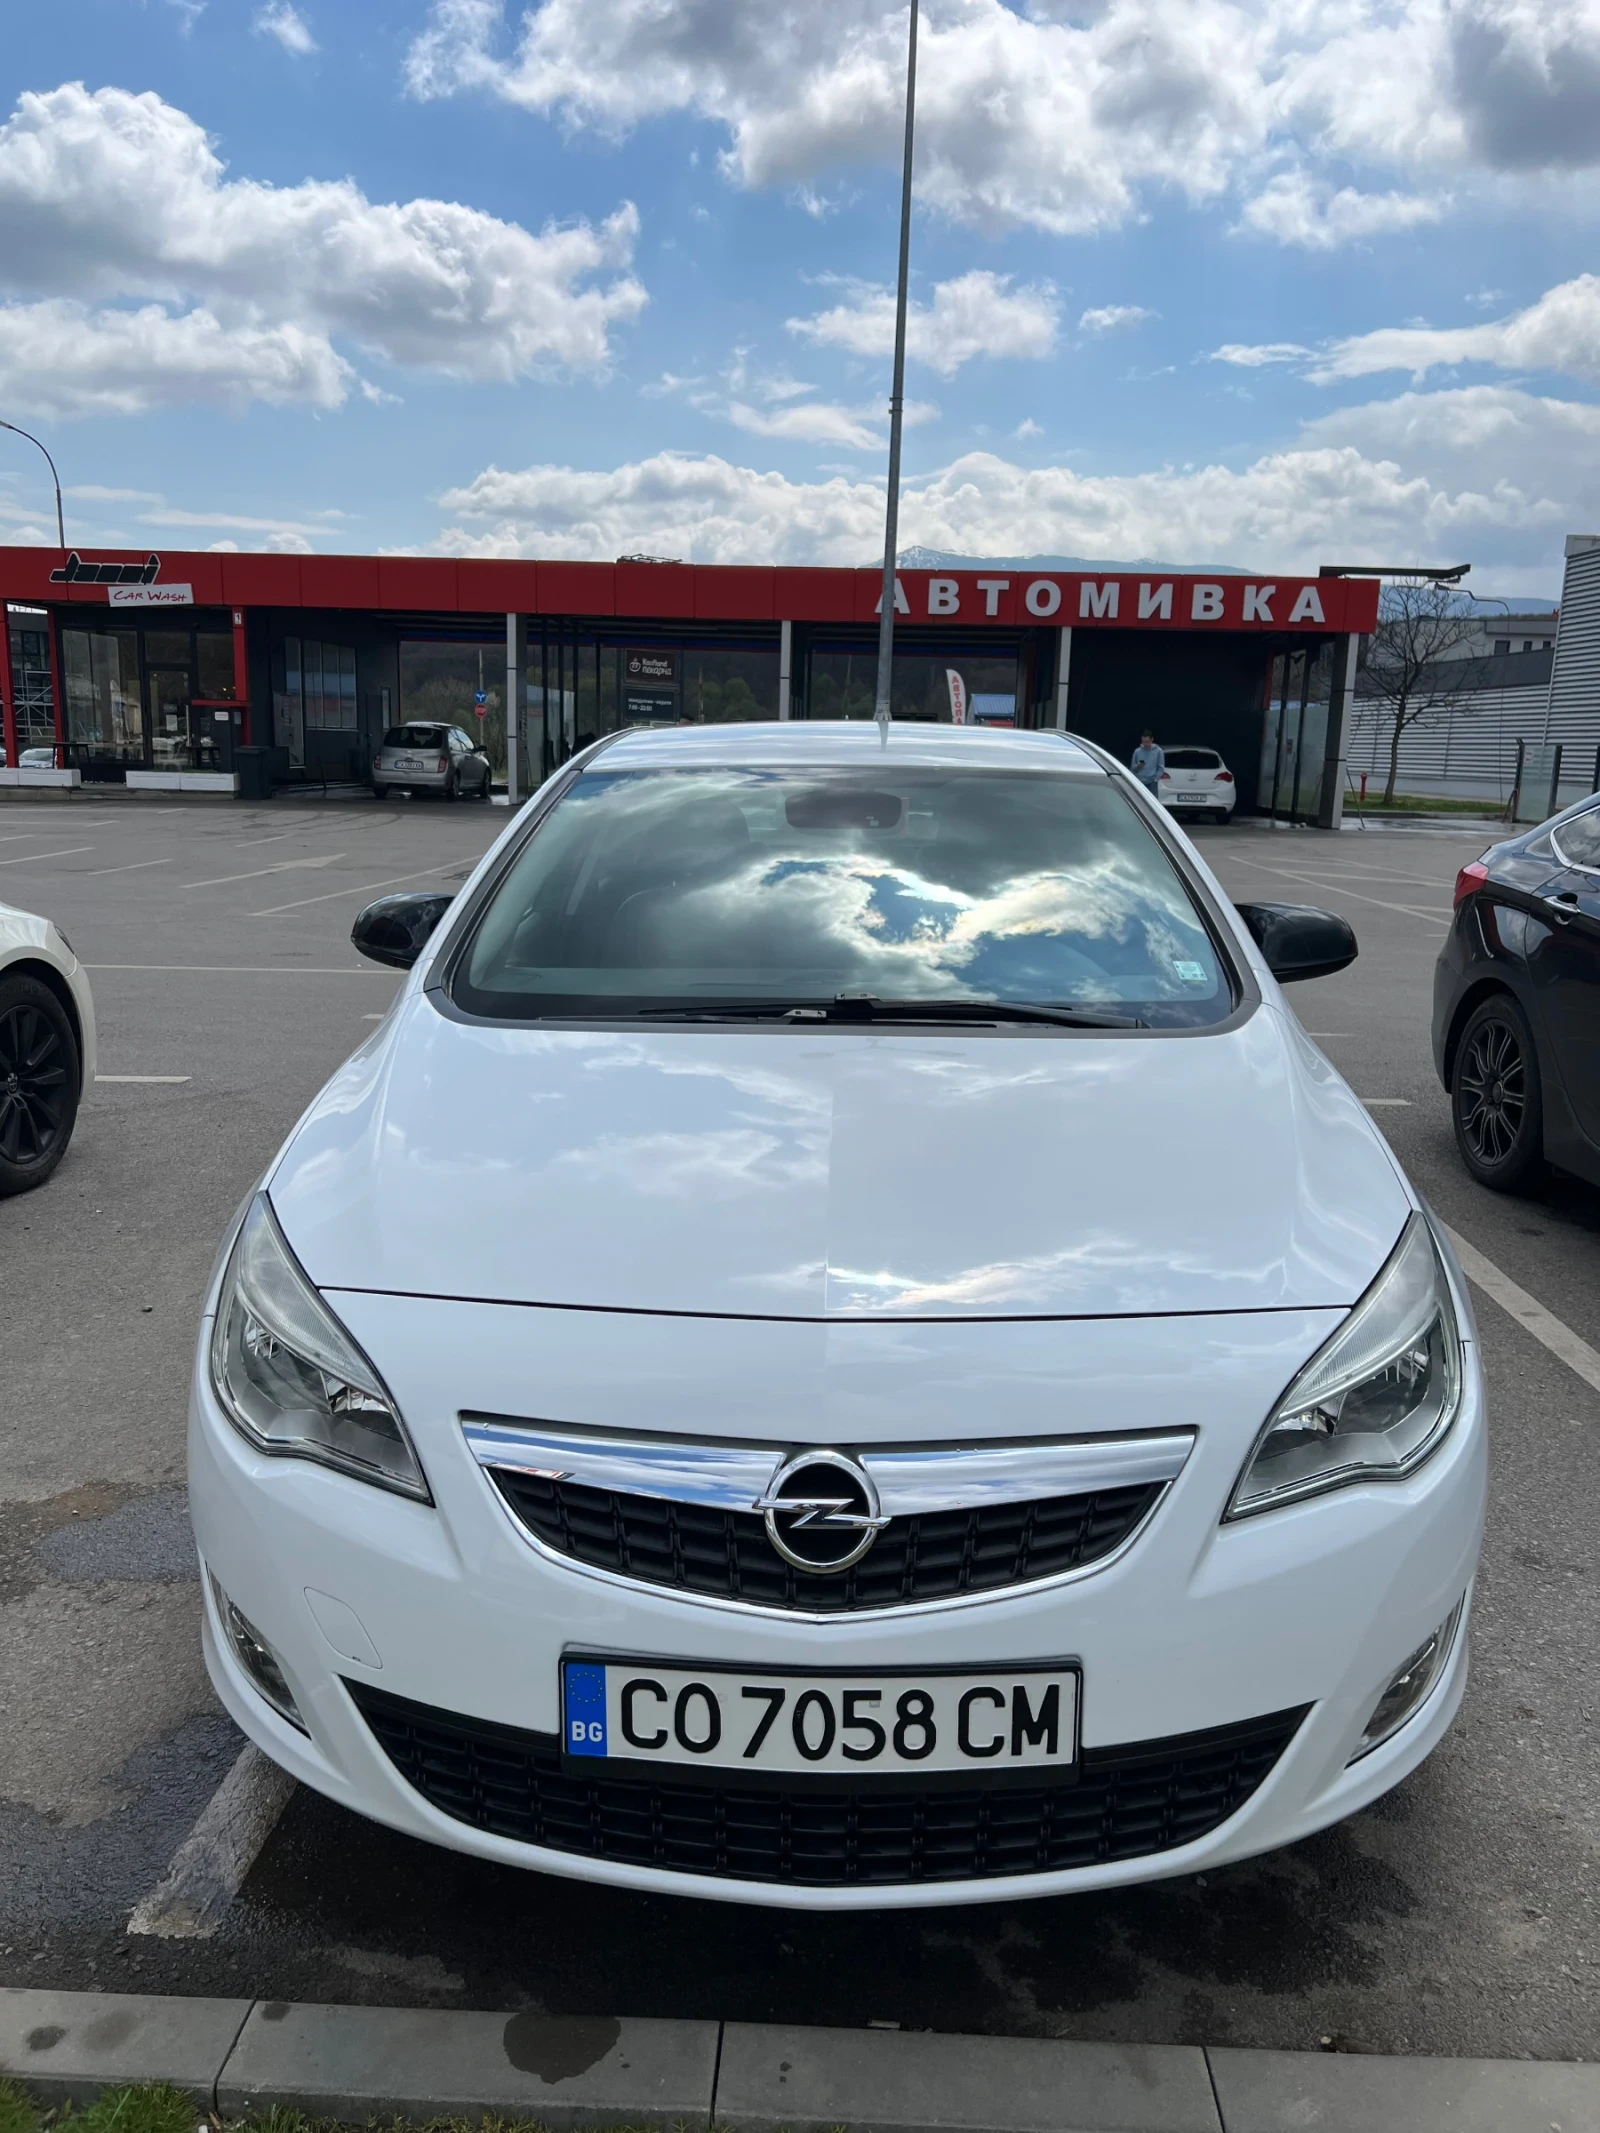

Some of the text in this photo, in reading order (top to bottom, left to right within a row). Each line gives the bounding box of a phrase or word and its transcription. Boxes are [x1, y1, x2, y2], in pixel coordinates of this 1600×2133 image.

[114, 591, 187, 603] CAR WASH
[874, 577, 1326, 624] АВТОМИВКА
[571, 1678, 1060, 1762] BG CO 7058 CM
